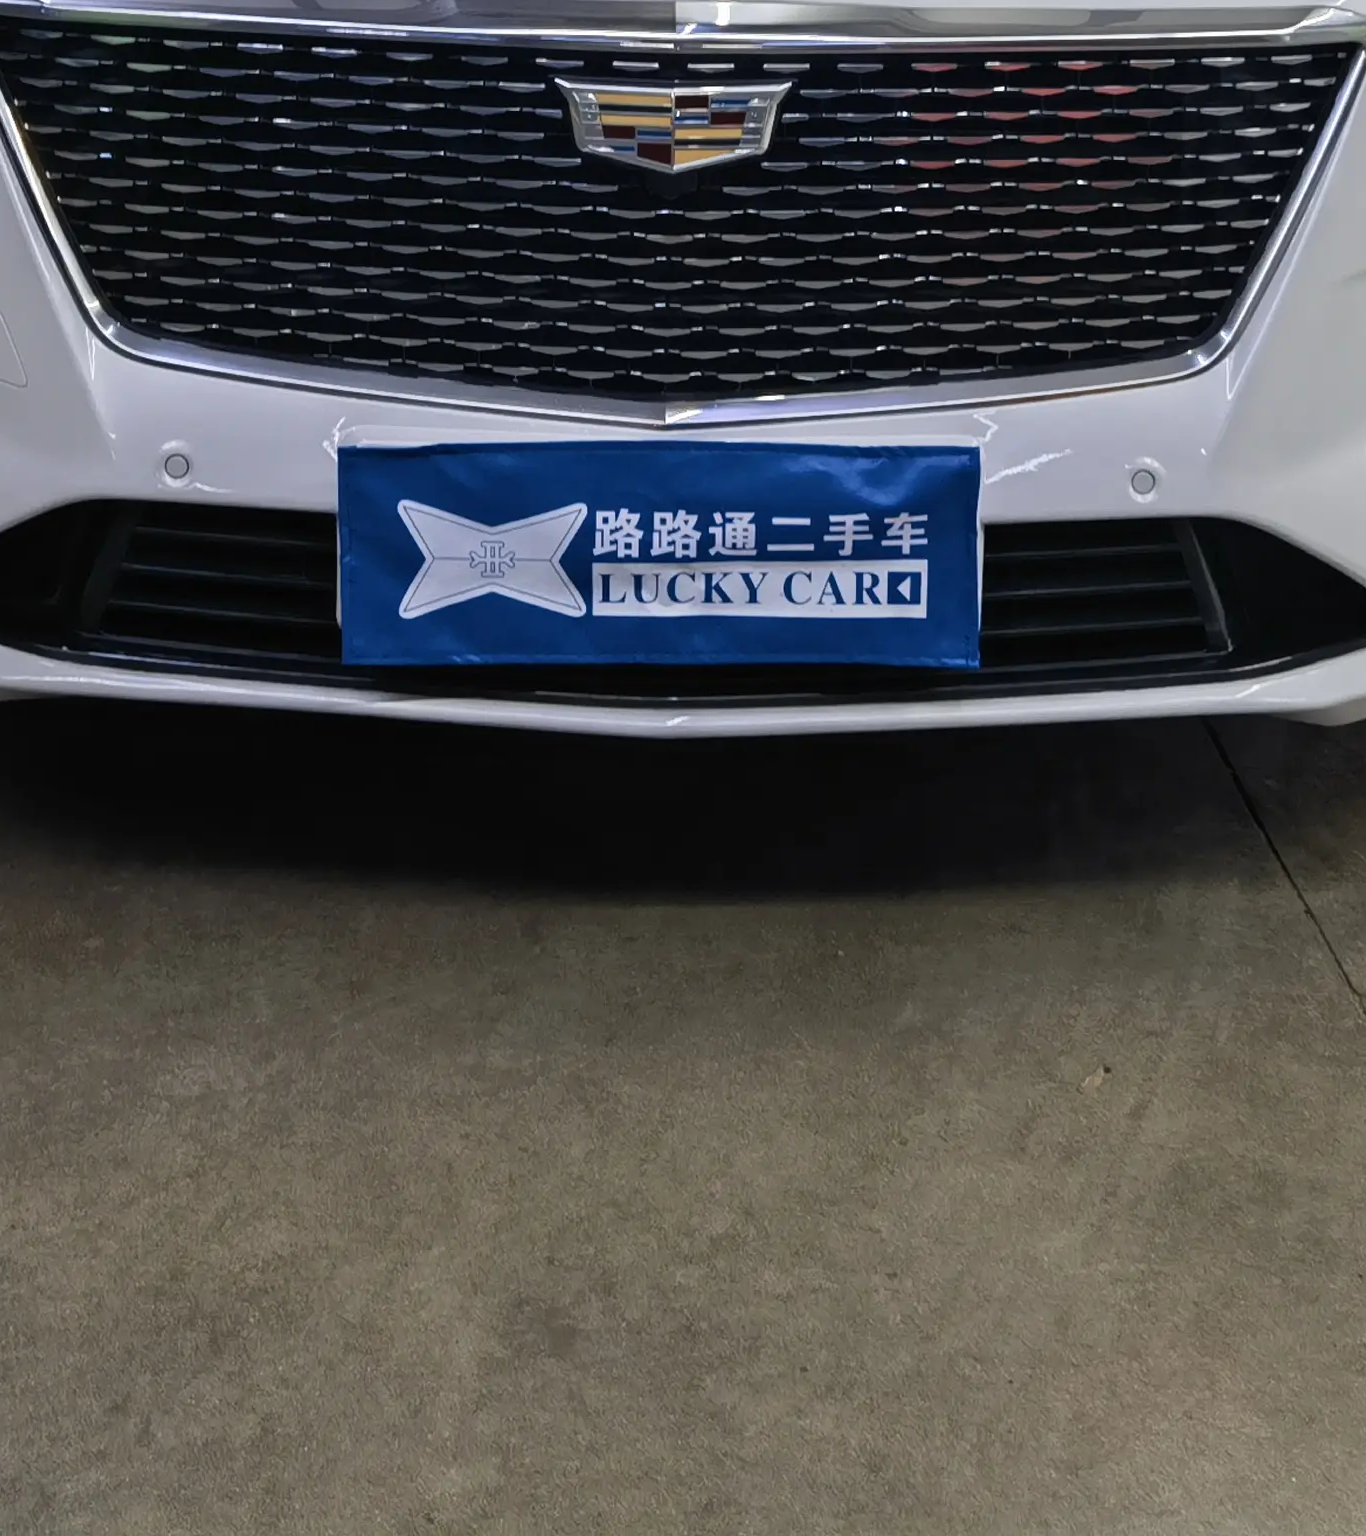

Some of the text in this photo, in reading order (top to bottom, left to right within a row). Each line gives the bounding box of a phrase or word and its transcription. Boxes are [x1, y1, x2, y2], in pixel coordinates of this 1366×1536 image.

[593, 508, 929, 559] 路路通二手车
[598, 570, 883, 606] LUCKY CAR
